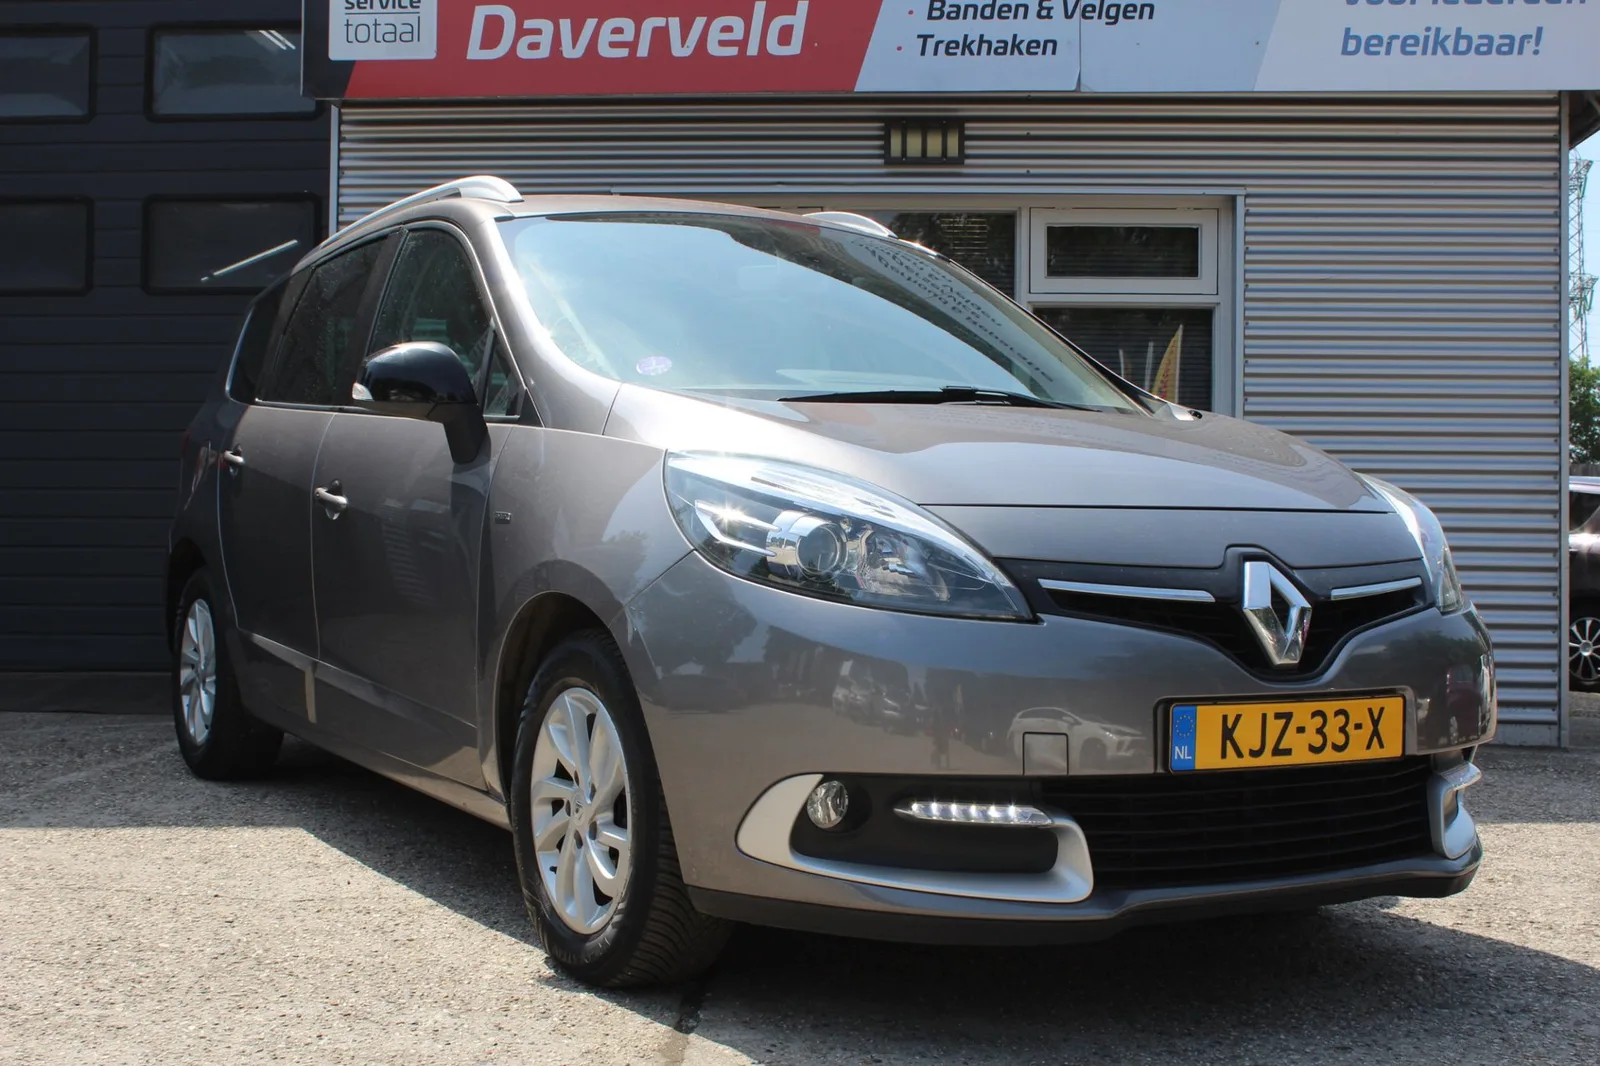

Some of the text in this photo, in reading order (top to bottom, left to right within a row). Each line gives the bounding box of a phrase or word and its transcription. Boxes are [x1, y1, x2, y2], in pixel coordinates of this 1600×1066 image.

[926, 0, 1155, 26] Banden & Velgen
[344, 16, 421, 45] totaal
[466, 0, 809, 61] Daverveld
[1341, 26, 1544, 56] bereikbaar!
[917, 34, 1058, 57] Trekhaken
[1220, 706, 1385, 760] KJZ-33-X
[1174, 745, 1192, 760] NL
